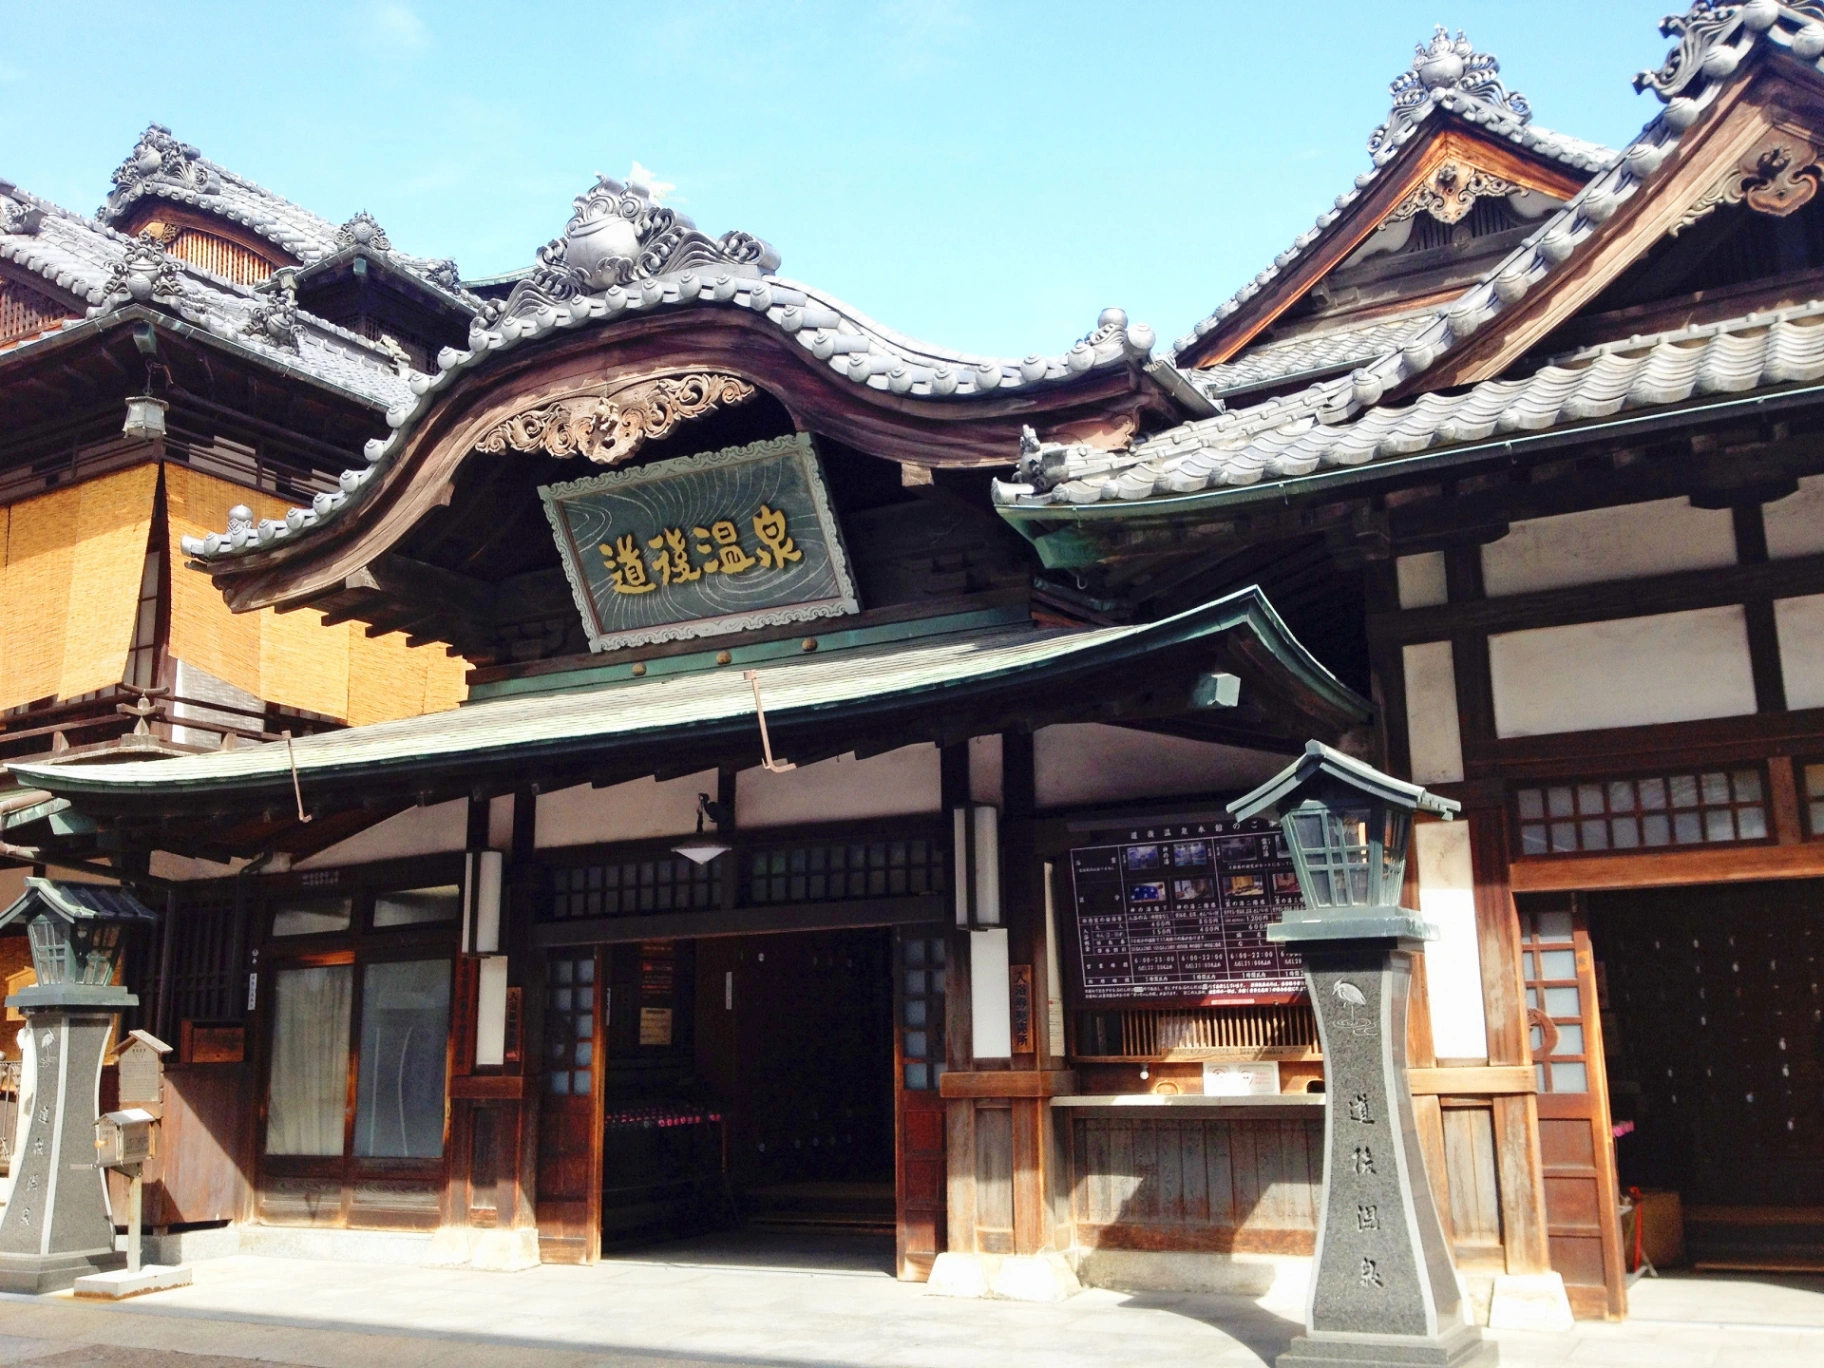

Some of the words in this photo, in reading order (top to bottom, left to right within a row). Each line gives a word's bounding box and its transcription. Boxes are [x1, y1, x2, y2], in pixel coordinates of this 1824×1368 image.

[600, 503, 802, 595] 道後温泉
[1349, 1092, 1385, 1288] 道後温泉
